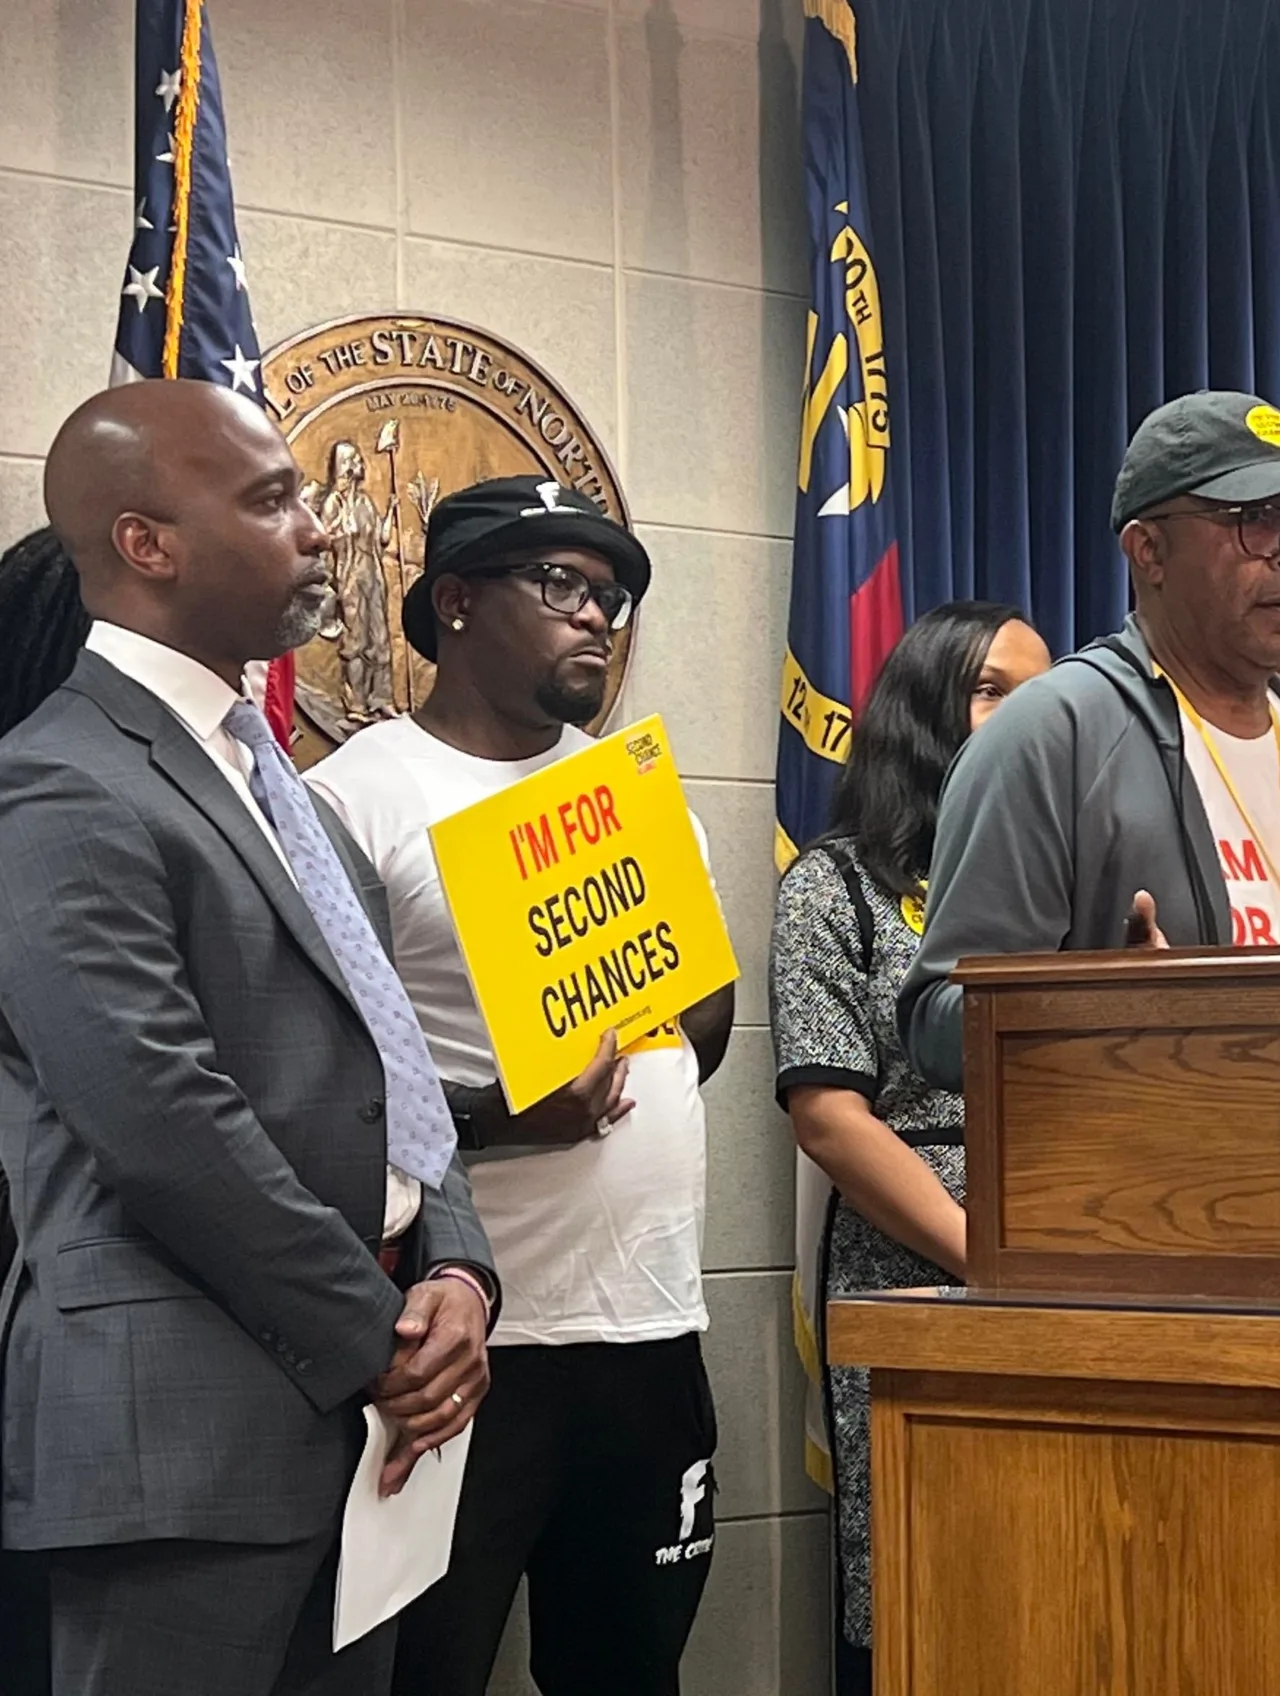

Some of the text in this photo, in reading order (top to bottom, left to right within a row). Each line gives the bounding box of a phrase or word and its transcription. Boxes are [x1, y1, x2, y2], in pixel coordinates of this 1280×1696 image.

[284, 366, 313, 394] OF
[318, 342, 366, 376] THE
[371, 330, 491, 387] STATE
[494, 369, 524, 397] OF
[821, 709, 852, 752] 17
[509, 784, 623, 880] I'M FOR
[527, 855, 647, 957] SECOND
[541, 921, 680, 1038] CHANCES
